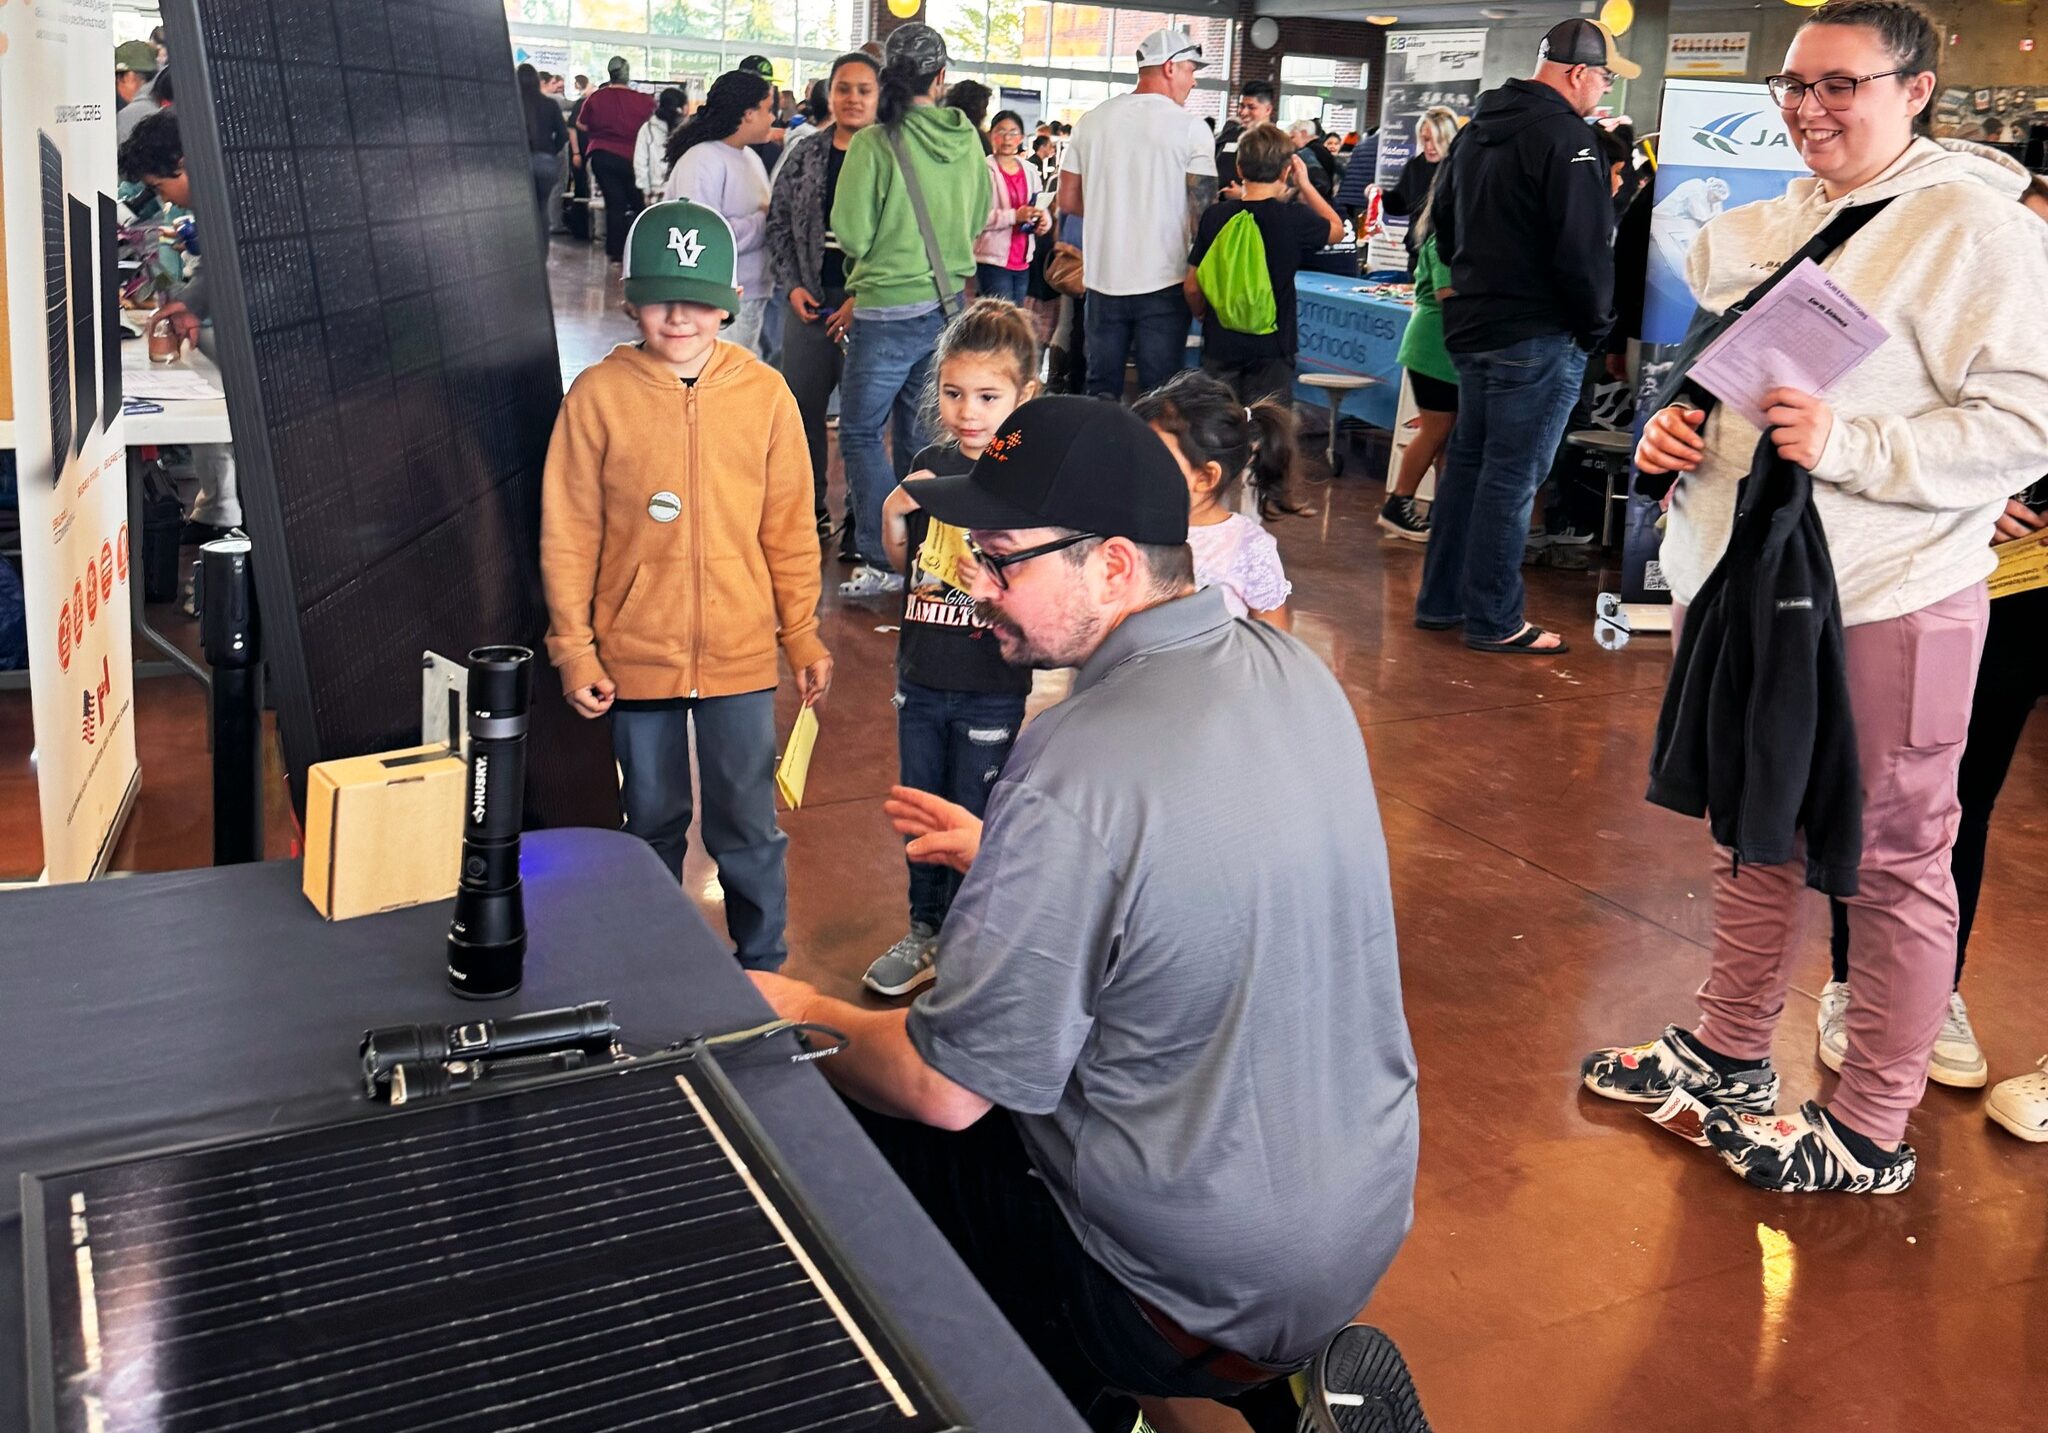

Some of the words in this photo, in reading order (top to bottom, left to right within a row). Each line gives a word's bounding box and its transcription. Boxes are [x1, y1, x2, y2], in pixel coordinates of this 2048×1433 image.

[1297, 300, 1396, 341] ommunities
[1299, 323, 1367, 364] Schools
[904, 594, 994, 629] HAMILTO
